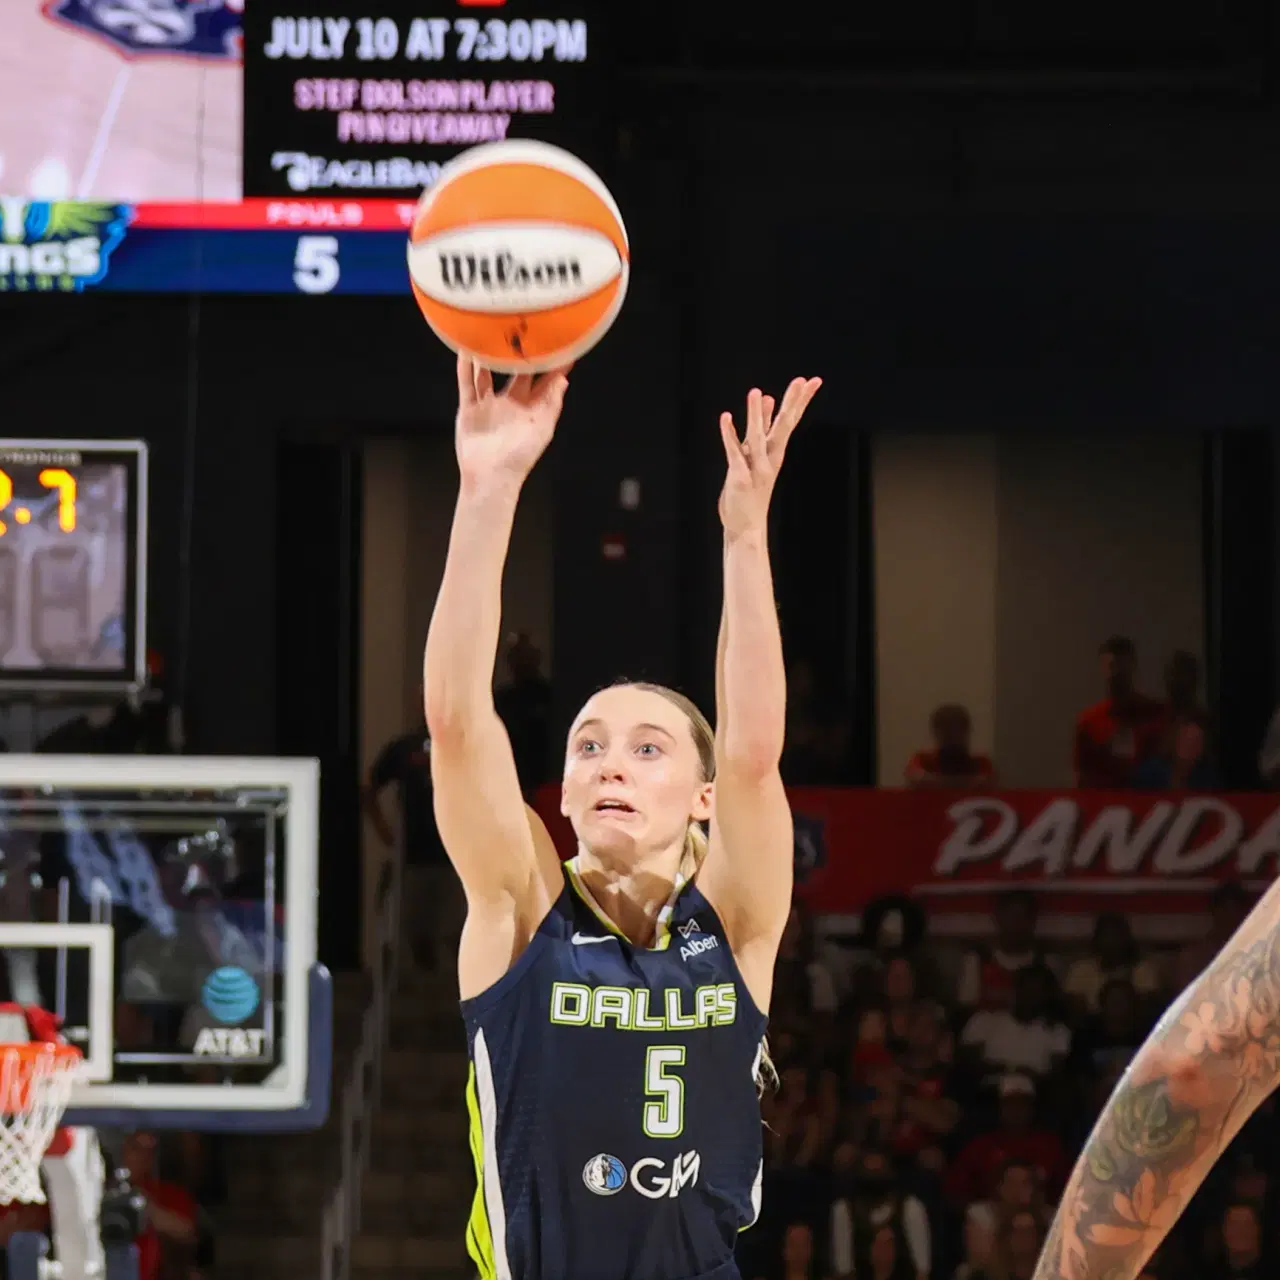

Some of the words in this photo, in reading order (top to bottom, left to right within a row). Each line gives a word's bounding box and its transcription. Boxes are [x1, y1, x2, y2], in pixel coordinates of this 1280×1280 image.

[264, 16, 350, 60] JULY
[355, 17, 399, 60] 10
[405, 18, 450, 61] AT
[454, 18, 587, 62] 7:30PM
[292, 235, 340, 295] 5
[438, 246, 583, 294] Wilson
[549, 981, 737, 1031] DALLAS
[192, 1028, 266, 1058] AT&T
[642, 1045, 687, 1139] 5
